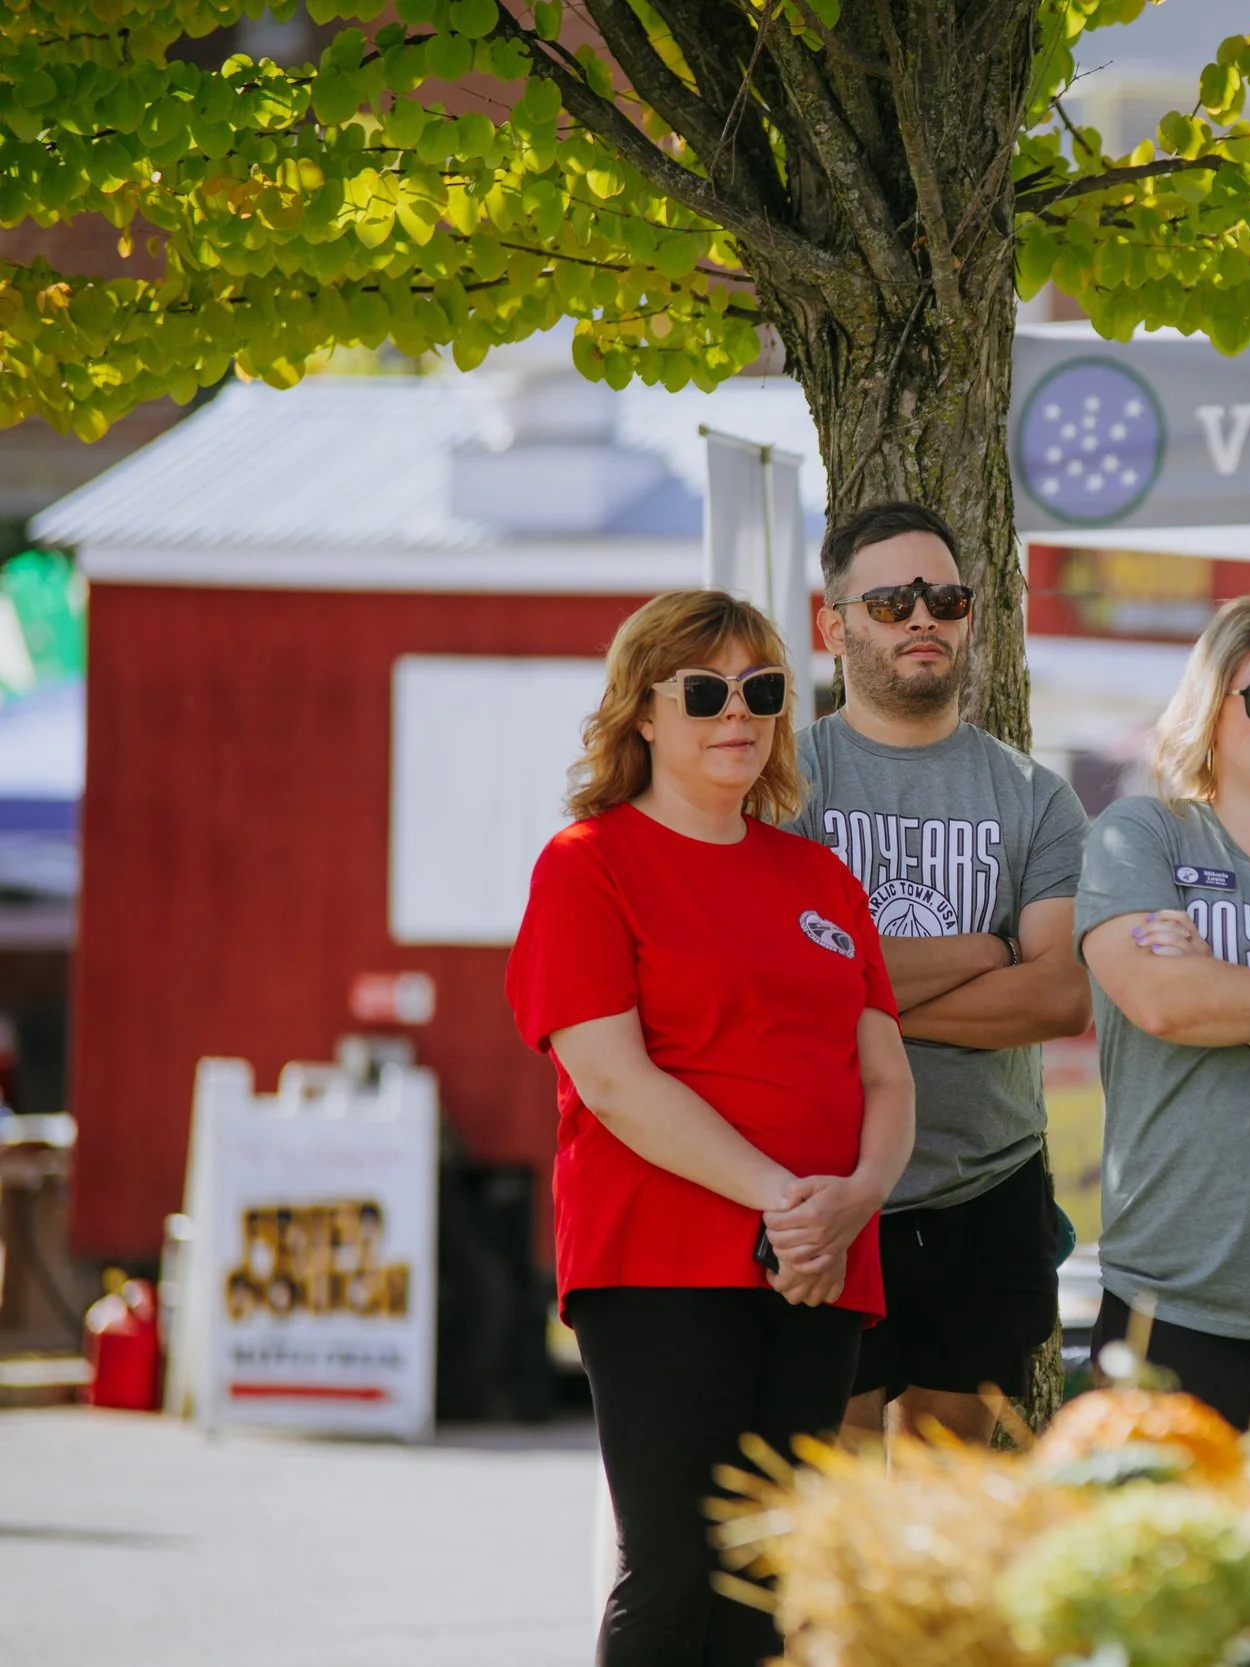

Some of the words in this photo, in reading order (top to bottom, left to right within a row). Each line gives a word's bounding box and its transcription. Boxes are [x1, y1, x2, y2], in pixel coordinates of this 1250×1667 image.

[869, 883, 897, 917] ARLIC
[899, 881, 934, 906] TOWN,
[936, 900, 957, 930] USA
[873, 811, 1001, 936] YEARS
